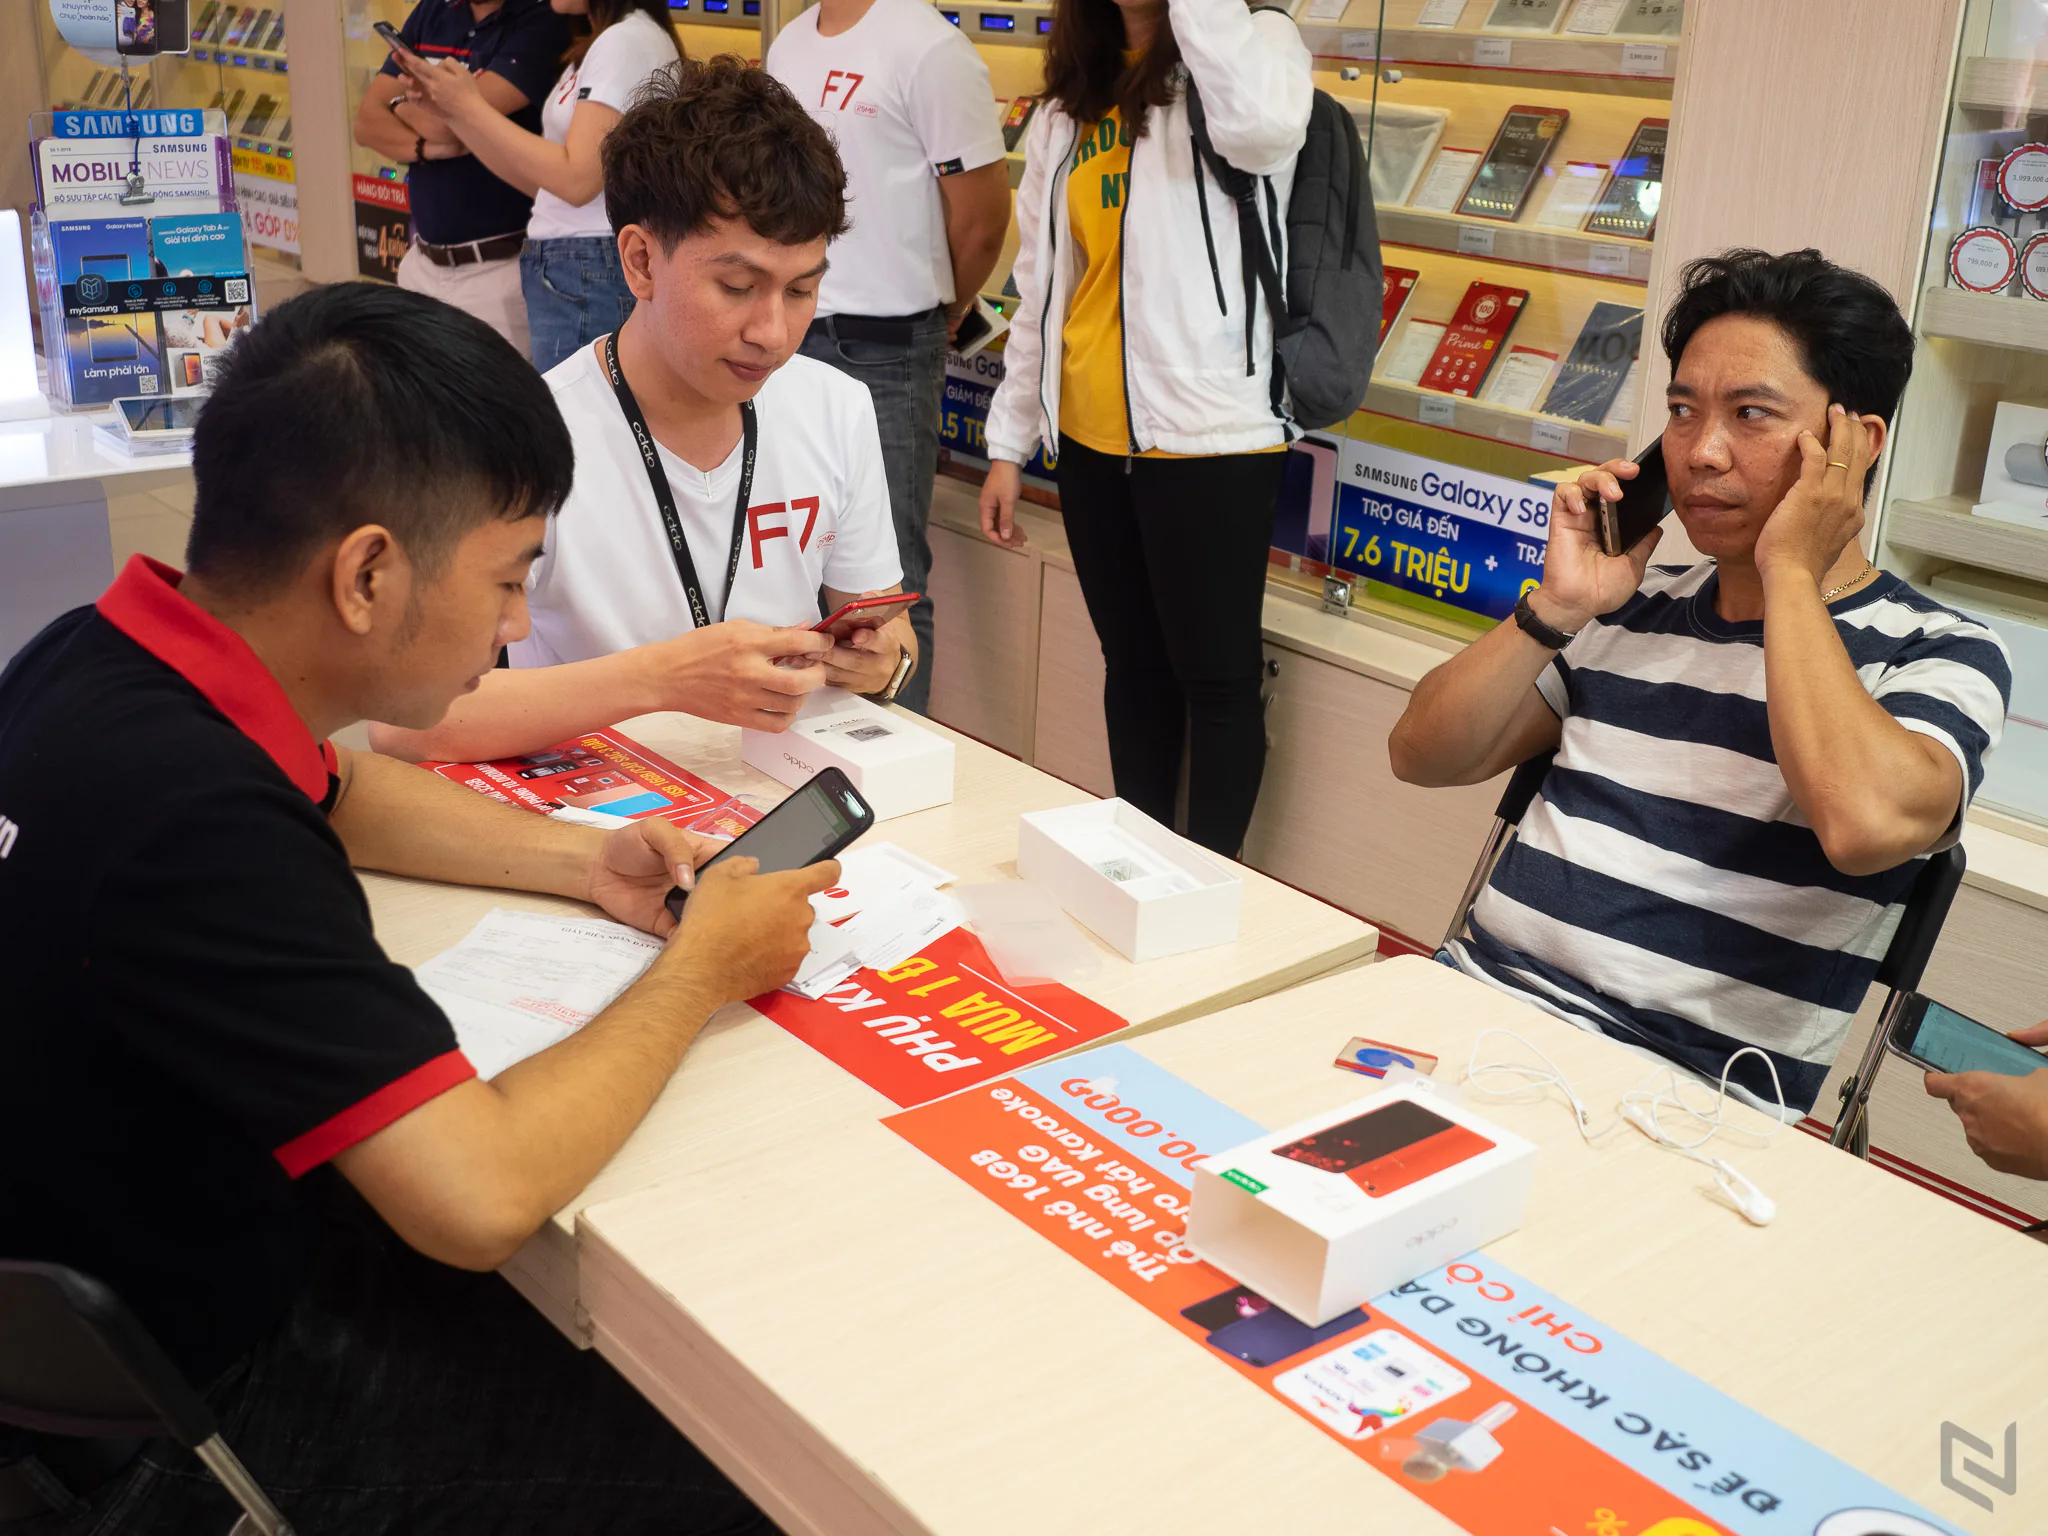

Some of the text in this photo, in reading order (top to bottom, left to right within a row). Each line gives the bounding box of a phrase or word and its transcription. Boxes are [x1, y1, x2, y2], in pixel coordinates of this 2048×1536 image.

[820, 69, 865, 111] F7
[65, 113, 195, 136] SAMSUNG
[153, 143, 208, 153] SAMSUNG
[147, 159, 209, 180] NEWS
[175, 189, 210, 198] SAMSUNG
[61, 224, 91, 232] SAMSUNG
[105, 223, 126, 231] Galaxy
[175, 226, 203, 236] Galaxy
[203, 224, 216, 232] Tab
[210, 233, 225, 241] cao
[255, 207, 281, 239] GÓP
[69, 304, 119, 316] mySamsung
[1478, 303, 1494, 315] 100
[1446, 332, 1482, 350] Prime
[84, 365, 150, 380] Làm phải lớn
[1354, 462, 1550, 528] SAMSUNG Galaxy S8
[746, 495, 820, 570] F7
[1361, 497, 1460, 542] TRỢ GIÁ ĐẾN
[1343, 526, 1382, 566] 7.6
[1390, 540, 1471, 598] TRIỆU
[906, 975, 961, 998] 1
[939, 991, 1058, 1056] MUA
[861, 1015, 983, 1073] PHỤ
[990, 1088, 1103, 1162] Karaoke
[1018, 1144, 1086, 1188] UAG
[1094, 1160, 1156, 1195] hát
[970, 1149, 1169, 1283] Thẻ nhớ 16GB
[1083, 1183, 1156, 1232] lưng
[1446, 1263, 1603, 1354] CHỈ CÒ
[1456, 1316, 1611, 1410] KHÔNG
[1614, 1411, 1712, 1471] SẠC
[1693, 1471, 1783, 1515] ĐẾ
